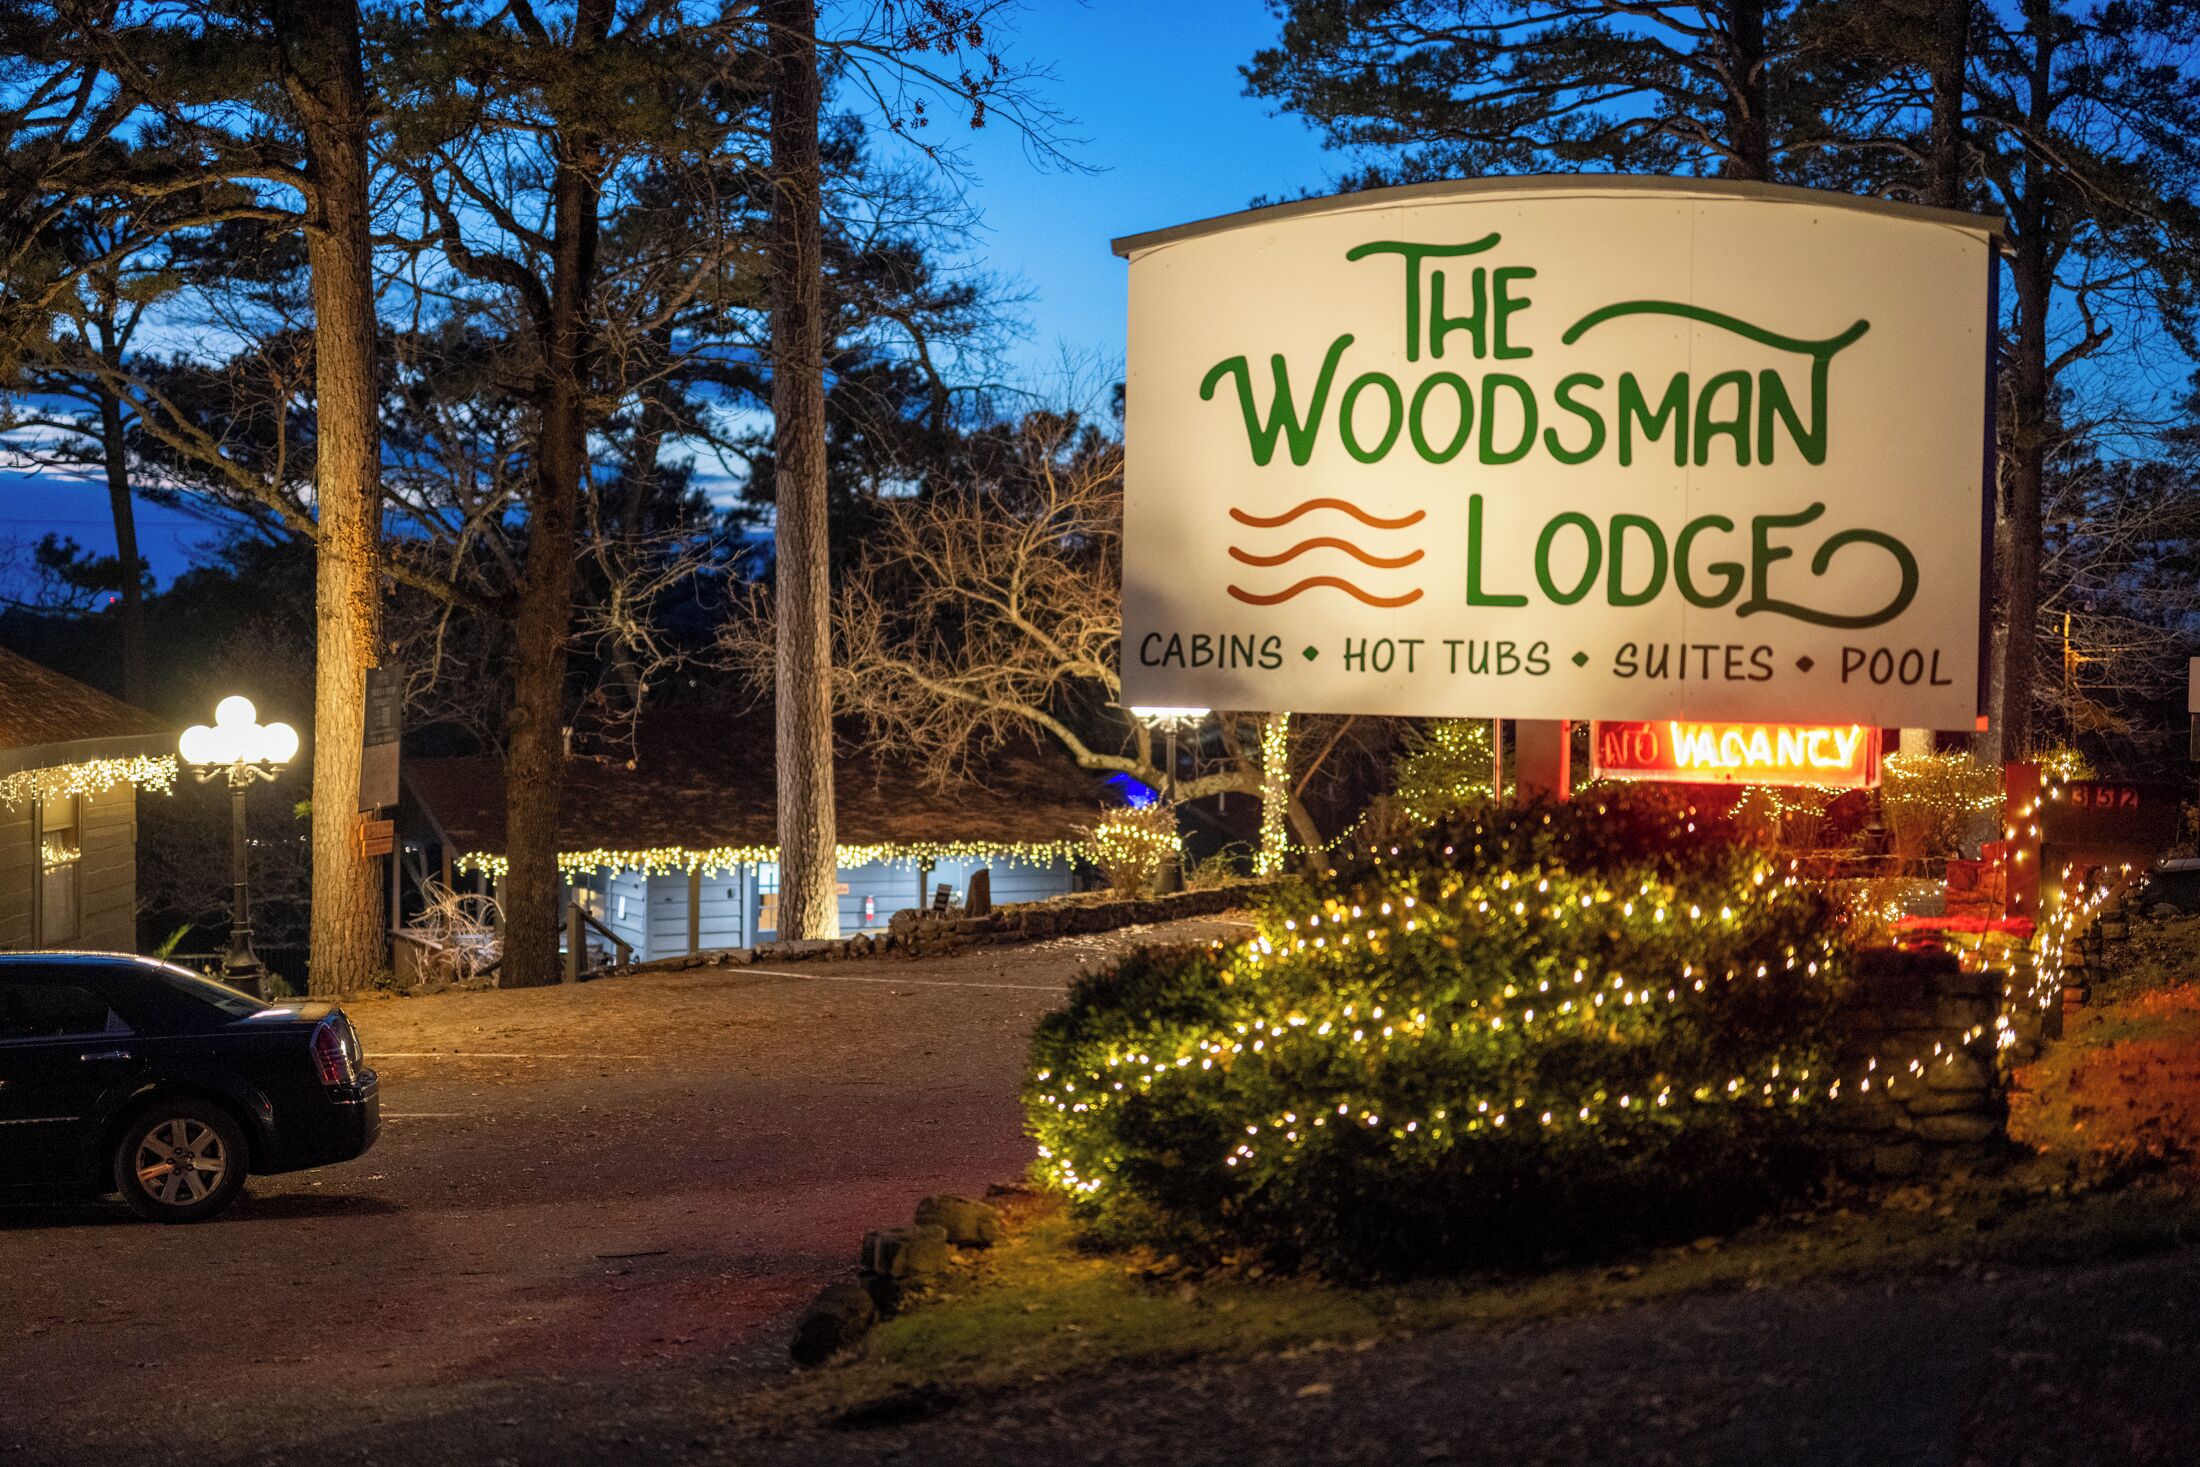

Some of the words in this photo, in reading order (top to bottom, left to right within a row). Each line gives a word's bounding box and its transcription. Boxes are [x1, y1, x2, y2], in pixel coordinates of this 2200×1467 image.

[1346, 232, 1537, 362] THE
[1201, 300, 1870, 467] WOODSMAN
[1466, 493, 1919, 630] LODGE
[1140, 632, 1284, 669] CABINS
[1344, 637, 1425, 673] HOT
[1442, 639, 1551, 676] TUBS
[1613, 642, 1775, 682] SUITES
[1841, 646, 1953, 686] POOL
[1604, 723, 1658, 765] NO
[1670, 721, 1862, 768] VACANCY
